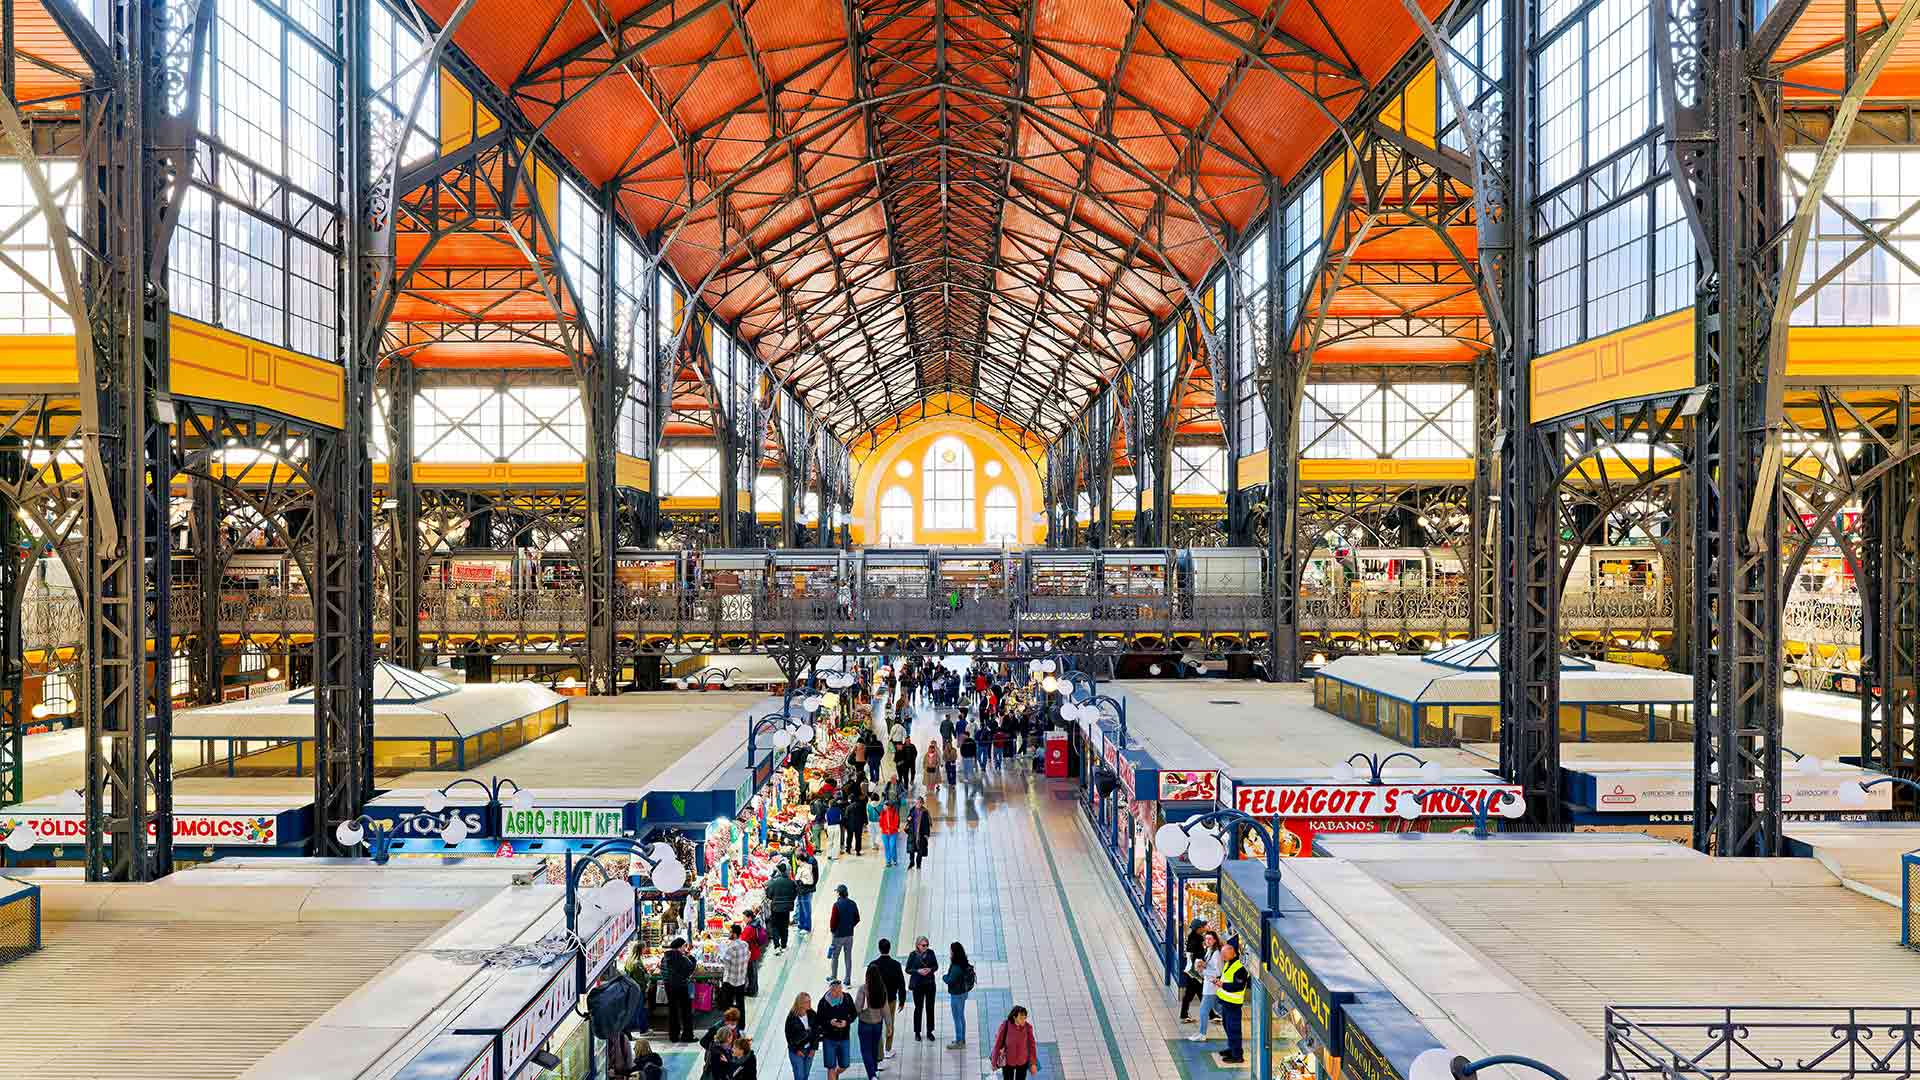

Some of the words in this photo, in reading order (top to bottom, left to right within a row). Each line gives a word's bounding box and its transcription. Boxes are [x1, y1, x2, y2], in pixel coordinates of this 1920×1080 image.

[1238, 786, 1375, 815] FELVÁGOTT
[505, 811, 593, 835] AGRO-FRUIT
[594, 811, 622, 834] KFT.
[1309, 820, 1375, 831] KABANOS
